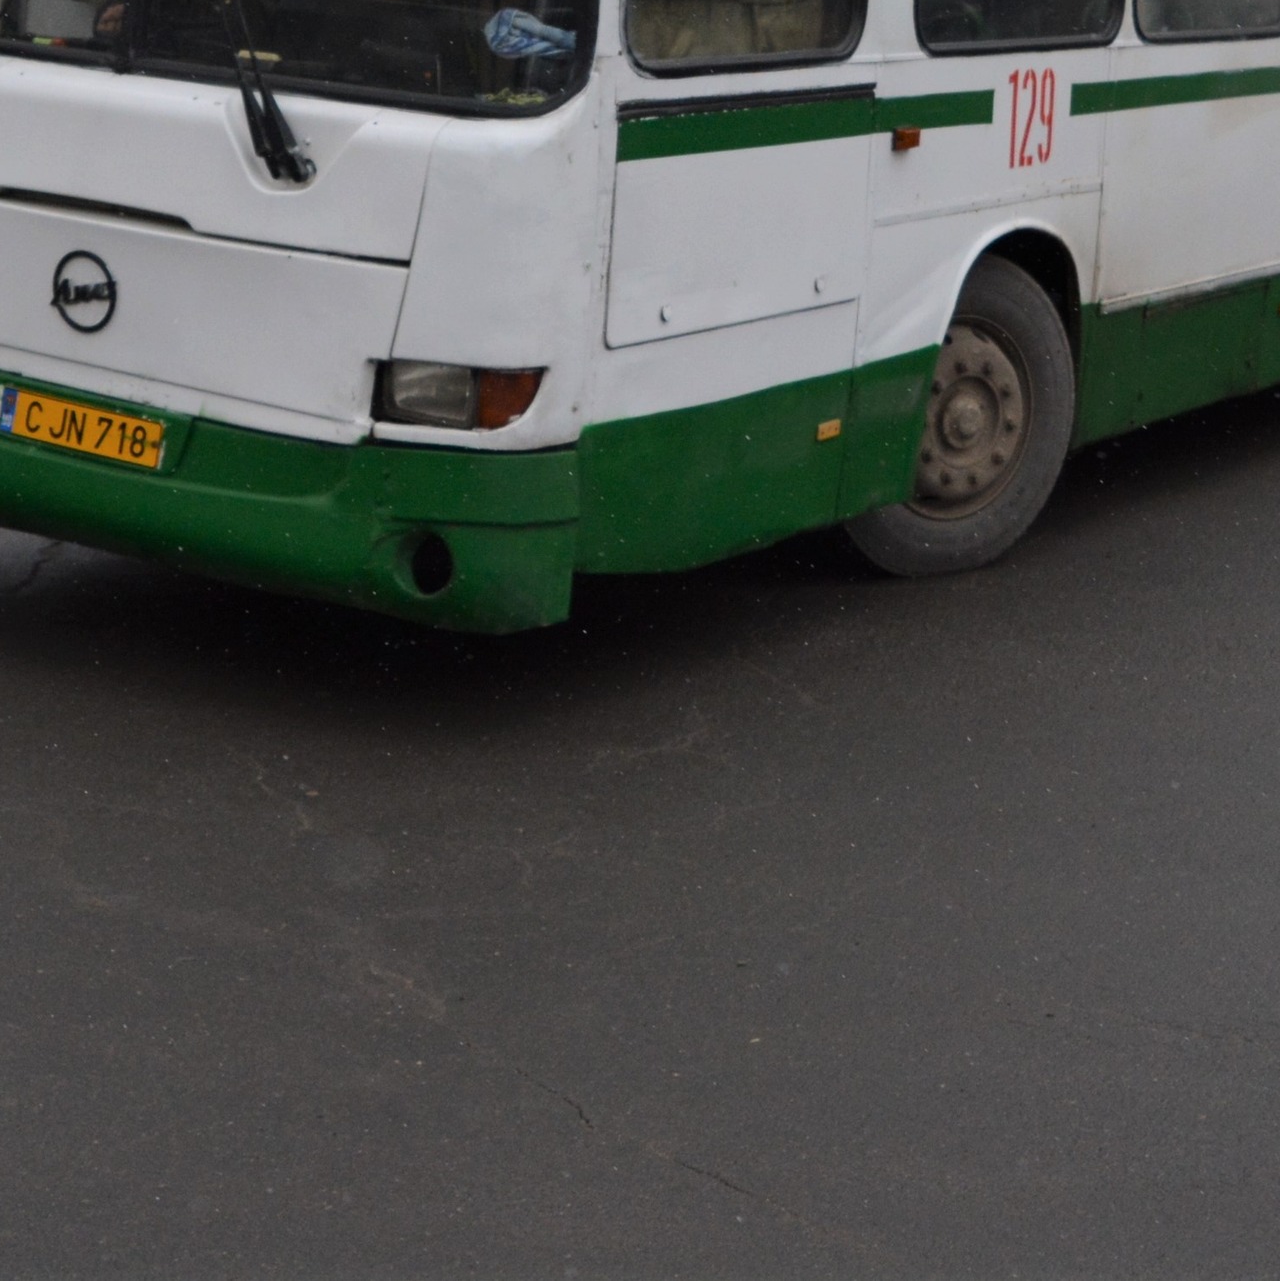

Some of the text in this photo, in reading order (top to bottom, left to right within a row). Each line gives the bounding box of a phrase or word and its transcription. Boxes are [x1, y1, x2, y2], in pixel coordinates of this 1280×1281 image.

[1008, 67, 1056, 169] 129
[24, 401, 148, 459] C JN 718
